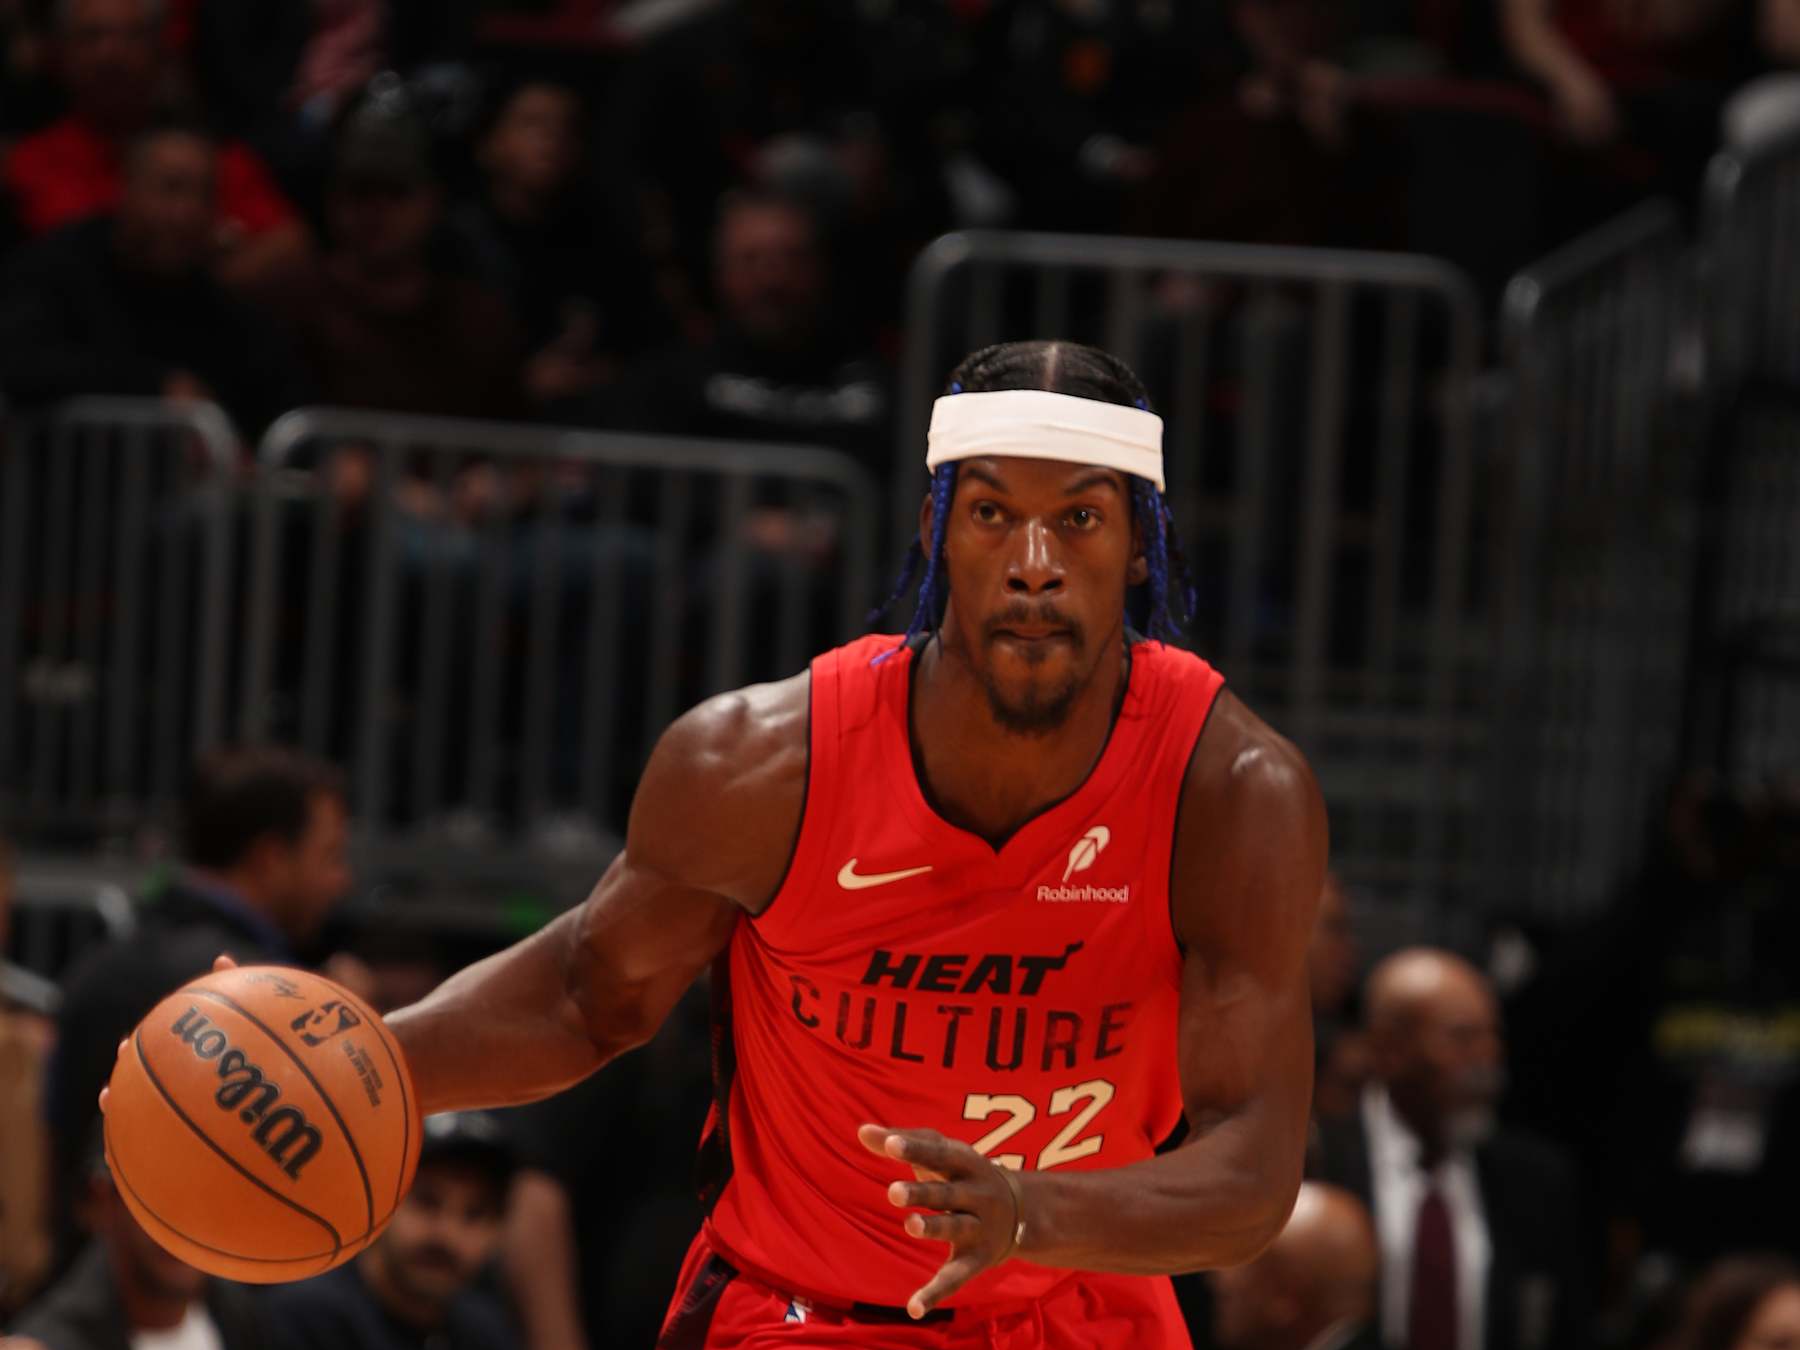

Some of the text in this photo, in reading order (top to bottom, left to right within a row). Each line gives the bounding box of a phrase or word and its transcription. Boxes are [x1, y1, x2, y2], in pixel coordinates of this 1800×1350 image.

[1037, 884, 1129, 903] Robinhood
[861, 940, 1084, 996] HEAT
[788, 974, 1133, 1073] CULTURE
[170, 1005, 323, 1183] Wilson
[961, 1079, 1115, 1172] 22
